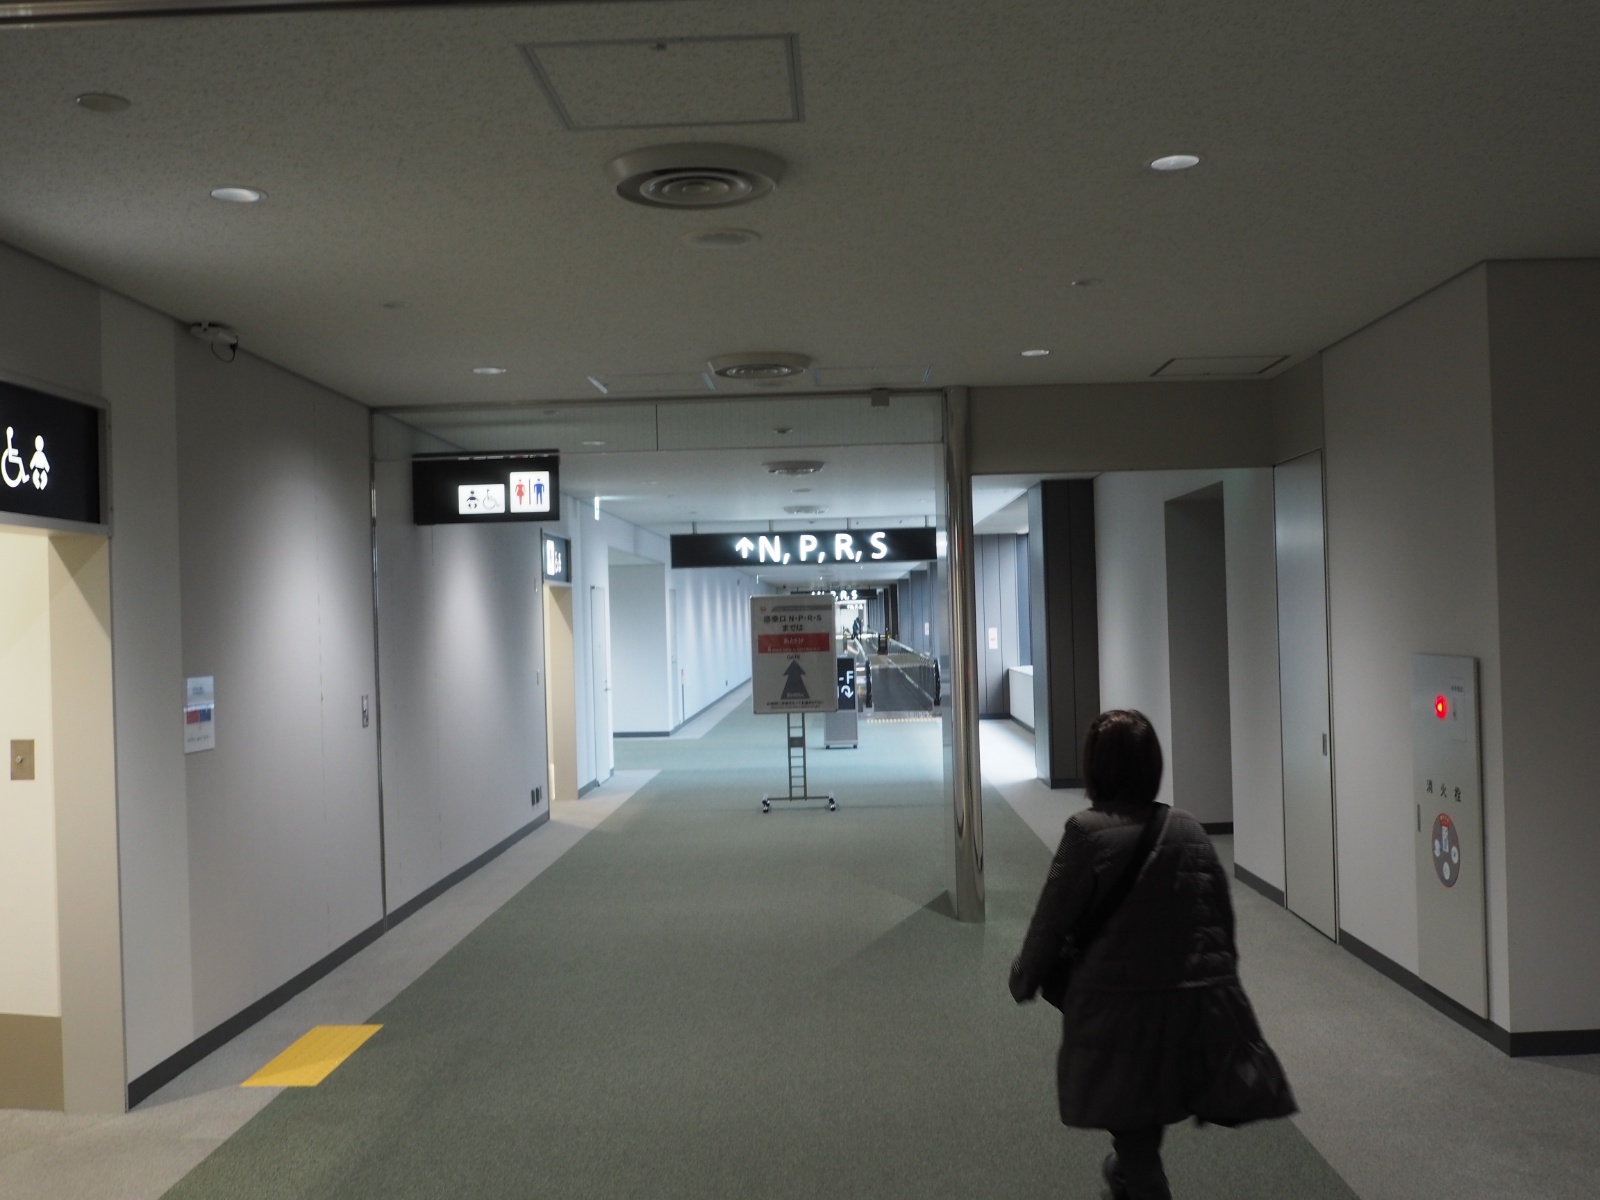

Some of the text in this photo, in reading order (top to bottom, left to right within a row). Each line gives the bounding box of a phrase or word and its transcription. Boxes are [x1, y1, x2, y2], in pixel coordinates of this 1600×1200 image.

[758, 531, 888, 565] N, P, R, S
